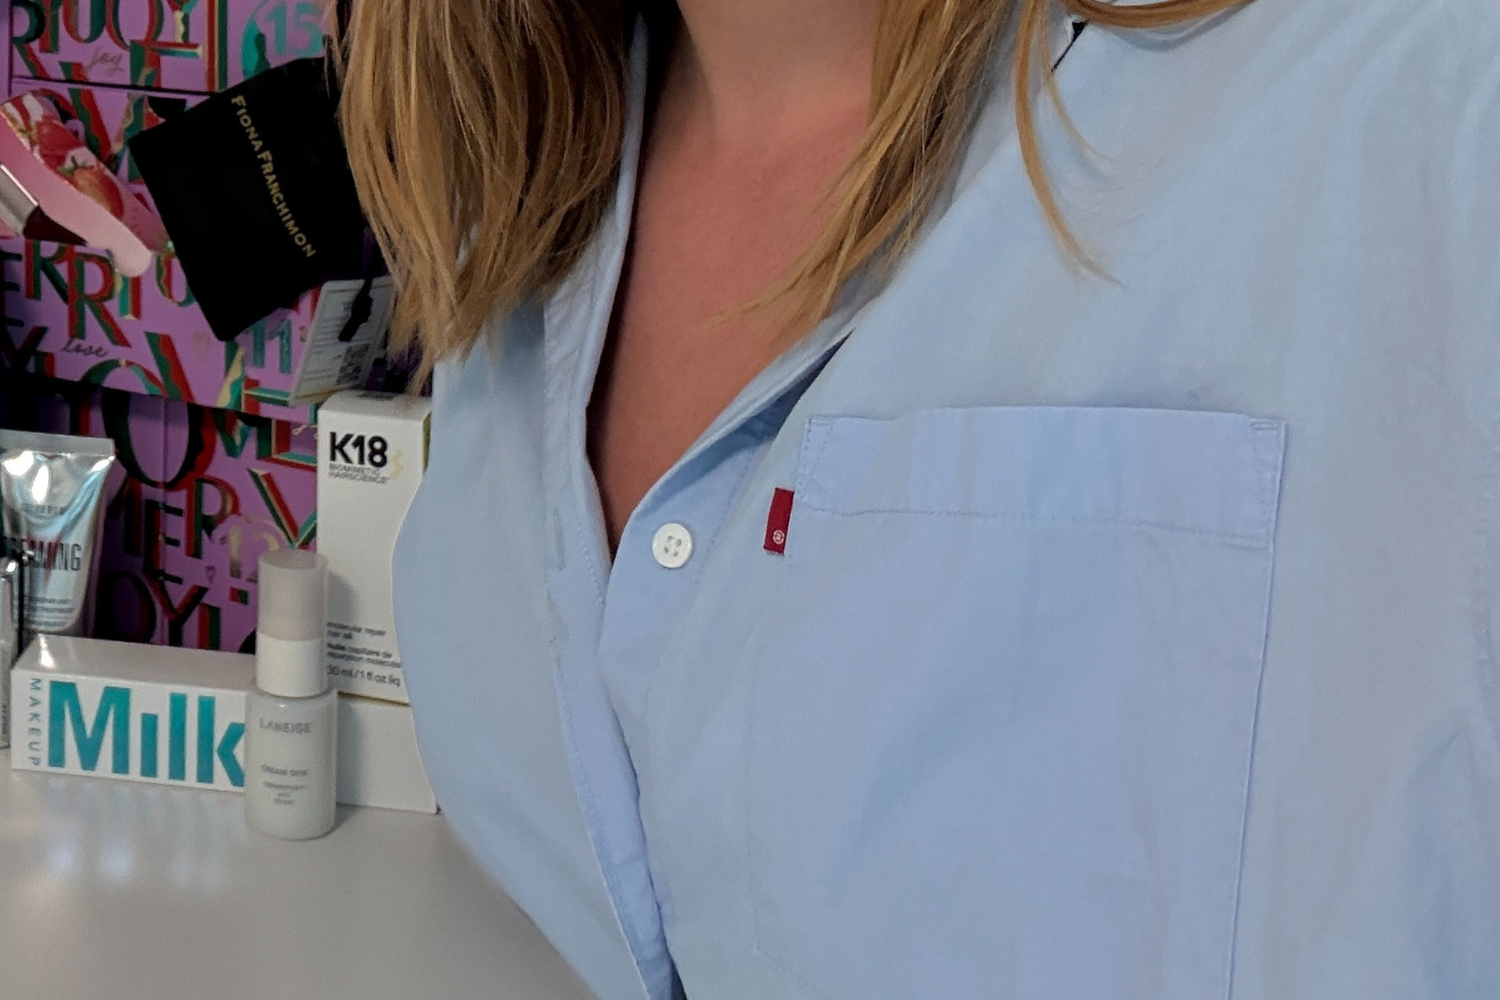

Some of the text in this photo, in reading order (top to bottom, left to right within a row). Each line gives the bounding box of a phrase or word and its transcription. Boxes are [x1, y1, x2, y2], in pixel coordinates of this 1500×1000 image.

[263, 1, 325, 57] 15
[231, 94, 316, 258] FIONA FRANCHIMON
[329, 430, 388, 469] K18
[28, 677, 42, 767] MAKEUP
[48, 680, 246, 788] Milk
[258, 716, 313, 735] LANEIGE
